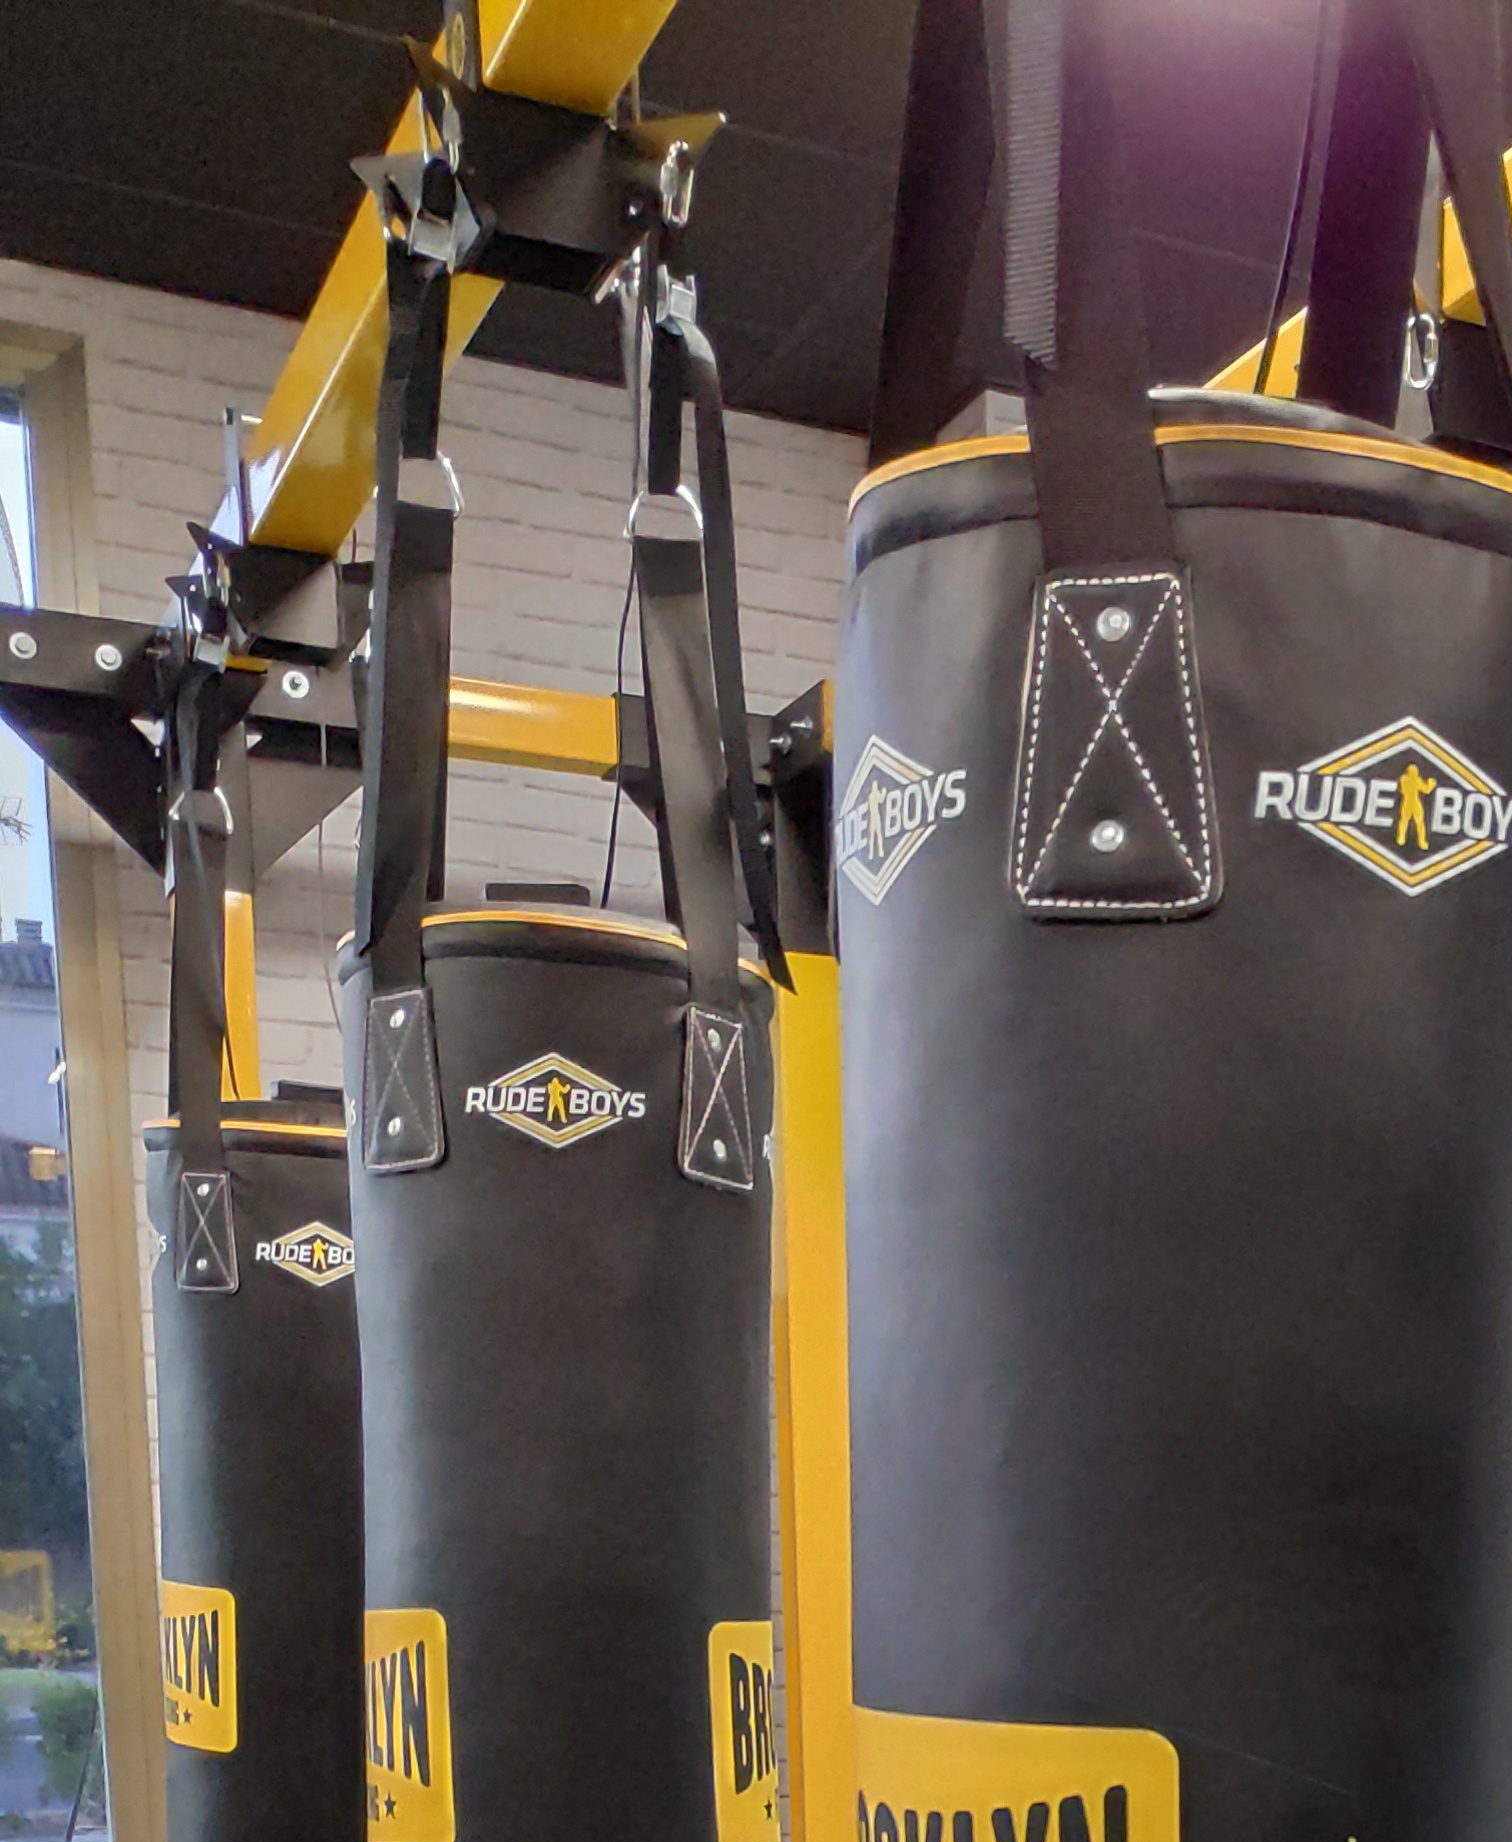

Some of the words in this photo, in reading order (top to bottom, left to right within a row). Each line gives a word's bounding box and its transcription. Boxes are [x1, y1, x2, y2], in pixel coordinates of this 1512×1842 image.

[836, 802, 868, 866] UDE
[885, 769, 967, 838] BOYS
[1254, 771, 1398, 828] RUDE
[464, 1086, 546, 1113] RUDE
[569, 1088, 647, 1118] BOYS
[255, 1241, 312, 1263] RUDE
[328, 1246, 355, 1265] BO
